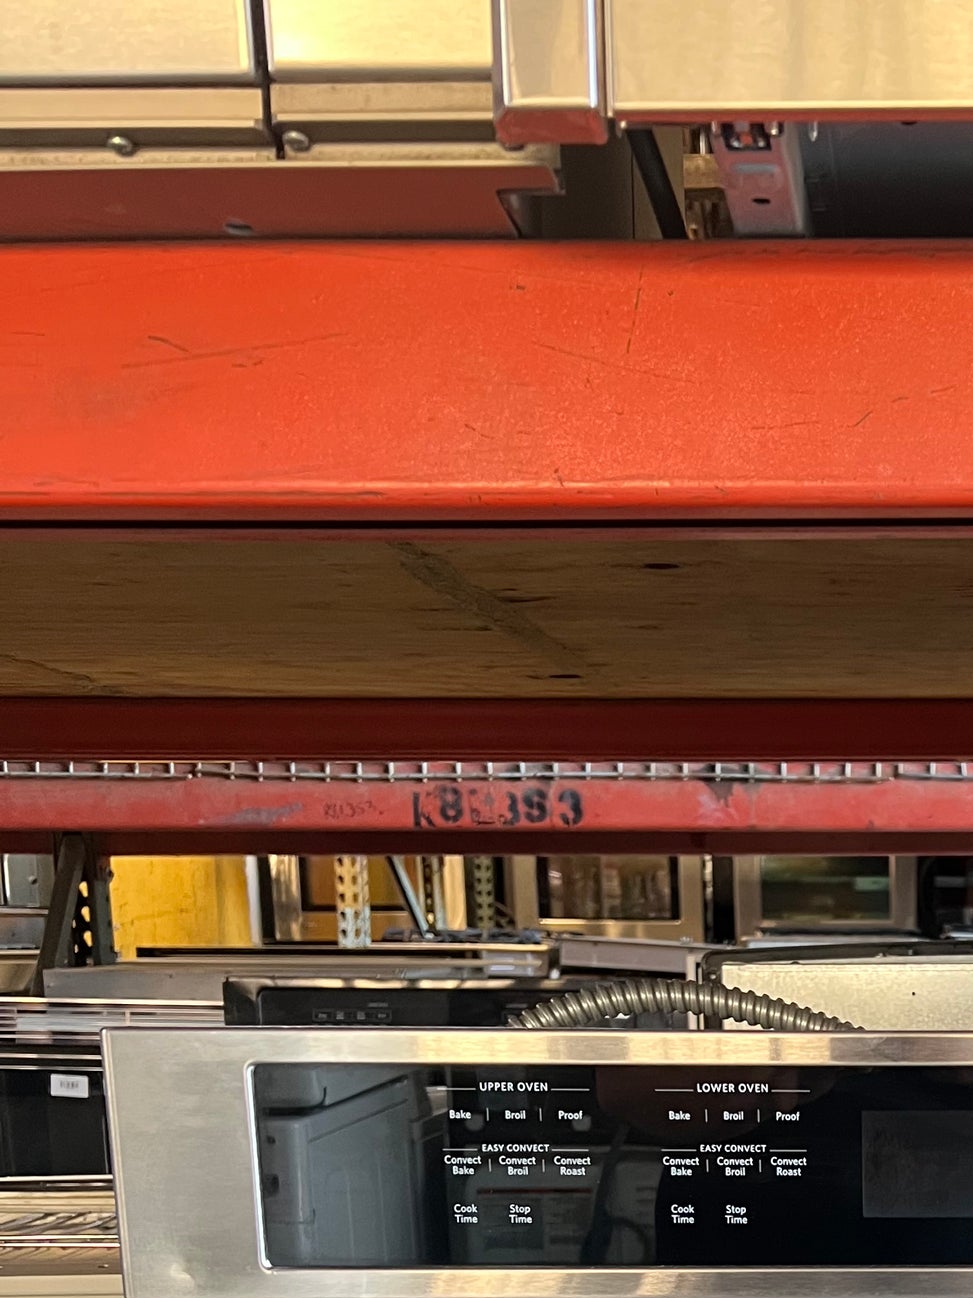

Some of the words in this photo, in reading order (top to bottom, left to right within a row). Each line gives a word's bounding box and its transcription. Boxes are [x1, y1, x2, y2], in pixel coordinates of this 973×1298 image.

[479, 1081, 514, 1092] UPPER
[516, 1081, 548, 1092] OVEN
[696, 1082, 735, 1093] LOWER
[738, 1083, 769, 1093] OVEN
[449, 1109, 472, 1120] Bake
[504, 1109, 526, 1120] Broil
[558, 1110, 583, 1120] Proof
[668, 1110, 691, 1121] Bake
[723, 1110, 744, 1121] Broil
[775, 1111, 800, 1121] Proof
[481, 1143, 505, 1152] EASY
[506, 1143, 550, 1153] CONVECT
[699, 1144, 723, 1153] EASY
[724, 1144, 767, 1153] CONVECT
[443, 1154, 482, 1165] Convect
[498, 1155, 537, 1165] Convect
[553, 1155, 591, 1166] Convect
[662, 1156, 700, 1166] Convect
[716, 1156, 754, 1166] Convect
[770, 1156, 807, 1166] Convect
[452, 1165, 475, 1175] Bake
[507, 1166, 529, 1176] Broil
[560, 1166, 586, 1176] Roast
[670, 1166, 693, 1176] Bake
[725, 1166, 746, 1177] Broil
[776, 1166, 802, 1177] Roast
[453, 1203, 478, 1213] Cook
[508, 1203, 531, 1217] Stop
[670, 1204, 695, 1214] Cook
[724, 1204, 747, 1217] Stop
[454, 1214, 478, 1224] Time
[508, 1214, 533, 1224] Time
[671, 1214, 695, 1224] Time
[724, 1214, 748, 1225] Time
